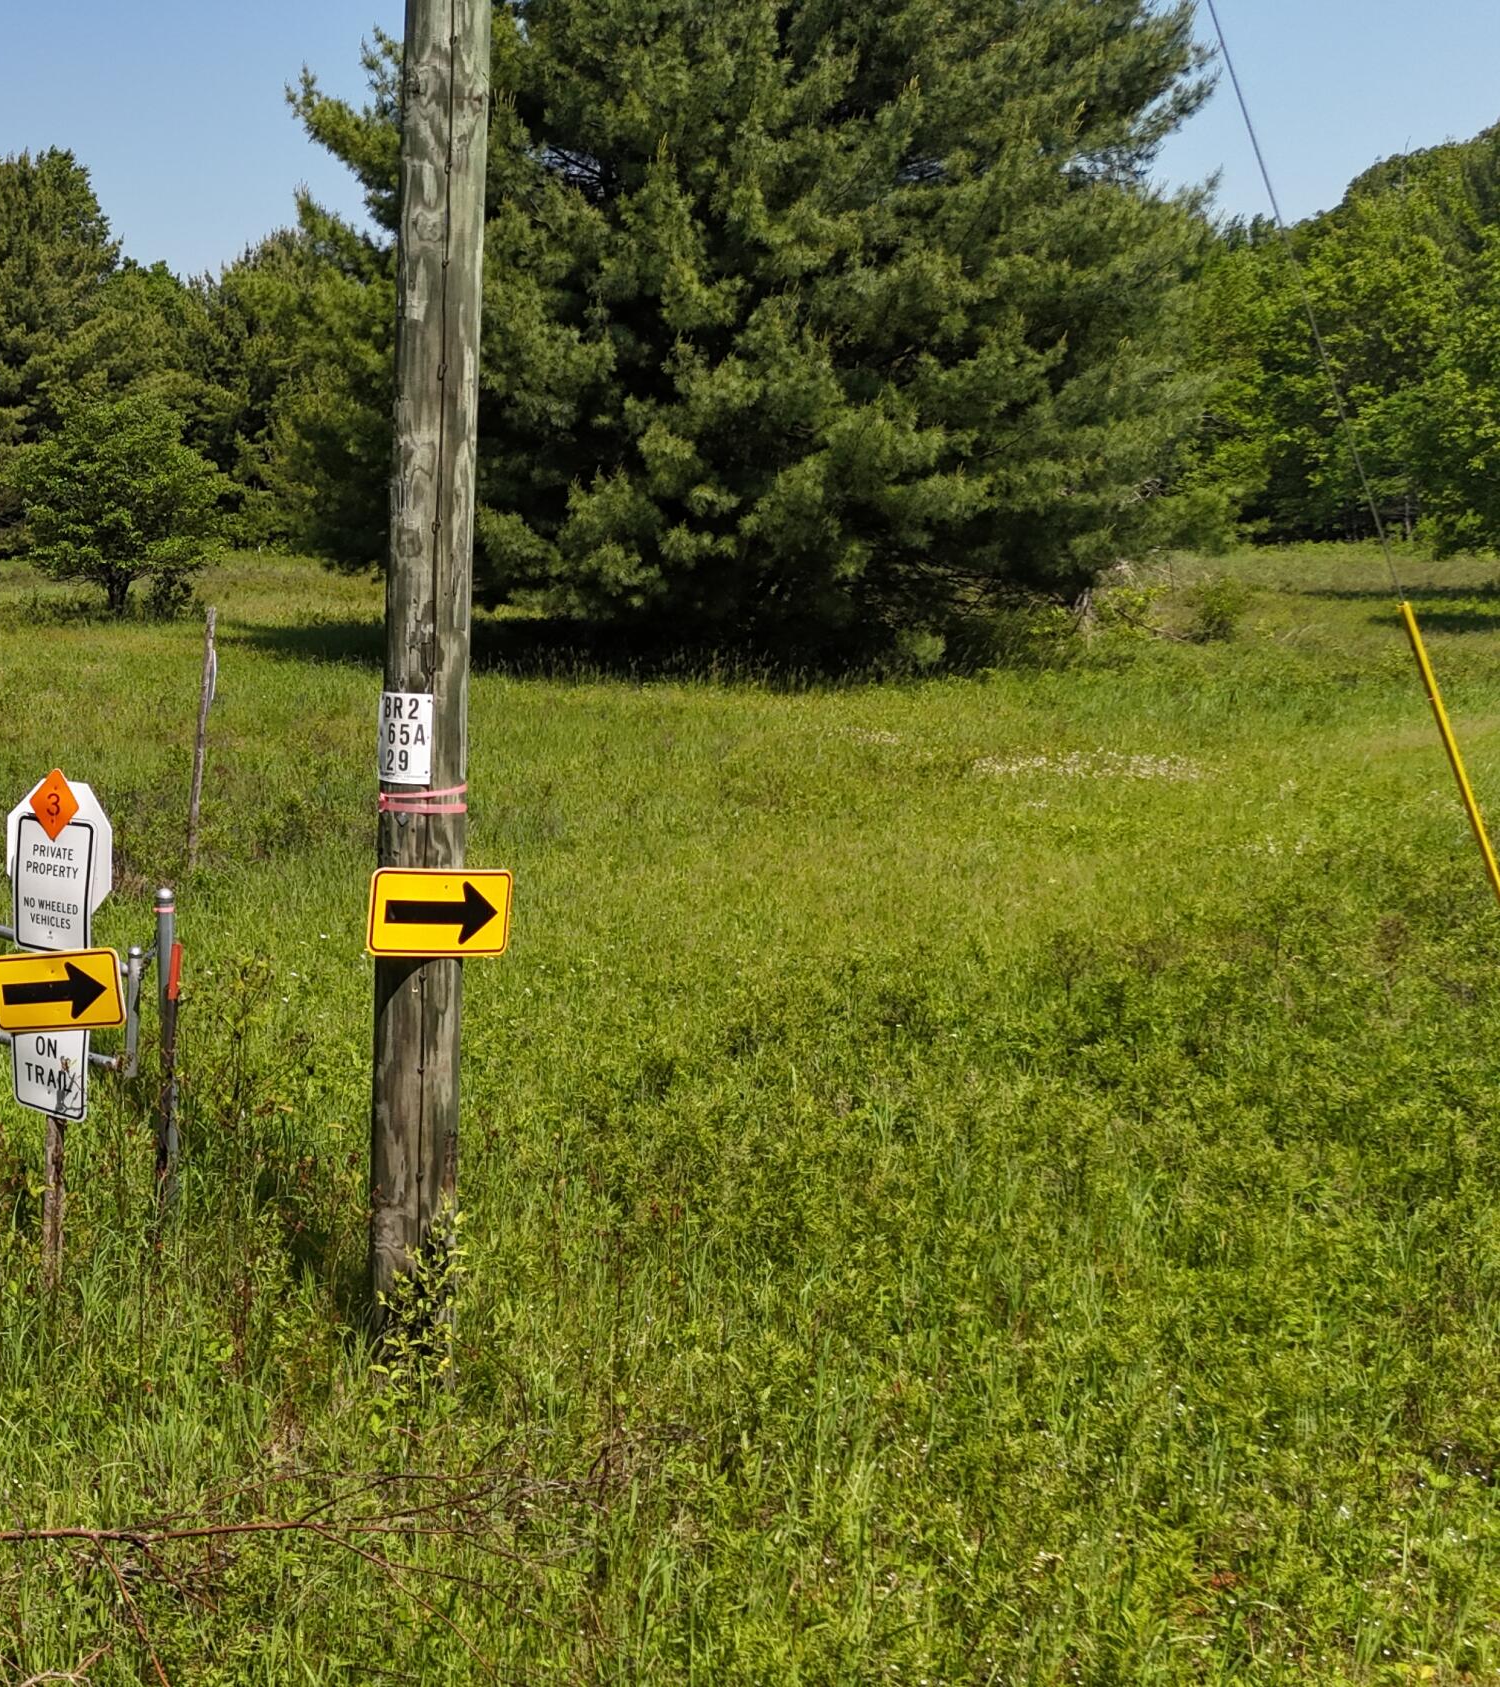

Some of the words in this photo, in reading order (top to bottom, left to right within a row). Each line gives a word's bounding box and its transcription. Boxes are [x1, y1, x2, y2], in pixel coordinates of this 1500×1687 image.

[388, 722, 426, 746] 65A
[386, 749, 409, 771] 29
[46, 793, 60, 816] 3
[32, 843, 74, 861] PRIVATE
[26, 860, 79, 880] PROPERTY
[23, 896, 36, 908] NO
[38, 898, 79, 915] WHEELED
[30, 912, 71, 930] VEHICLES
[35, 1035, 58, 1059] ON
[25, 1062, 72, 1093] TRAIL
